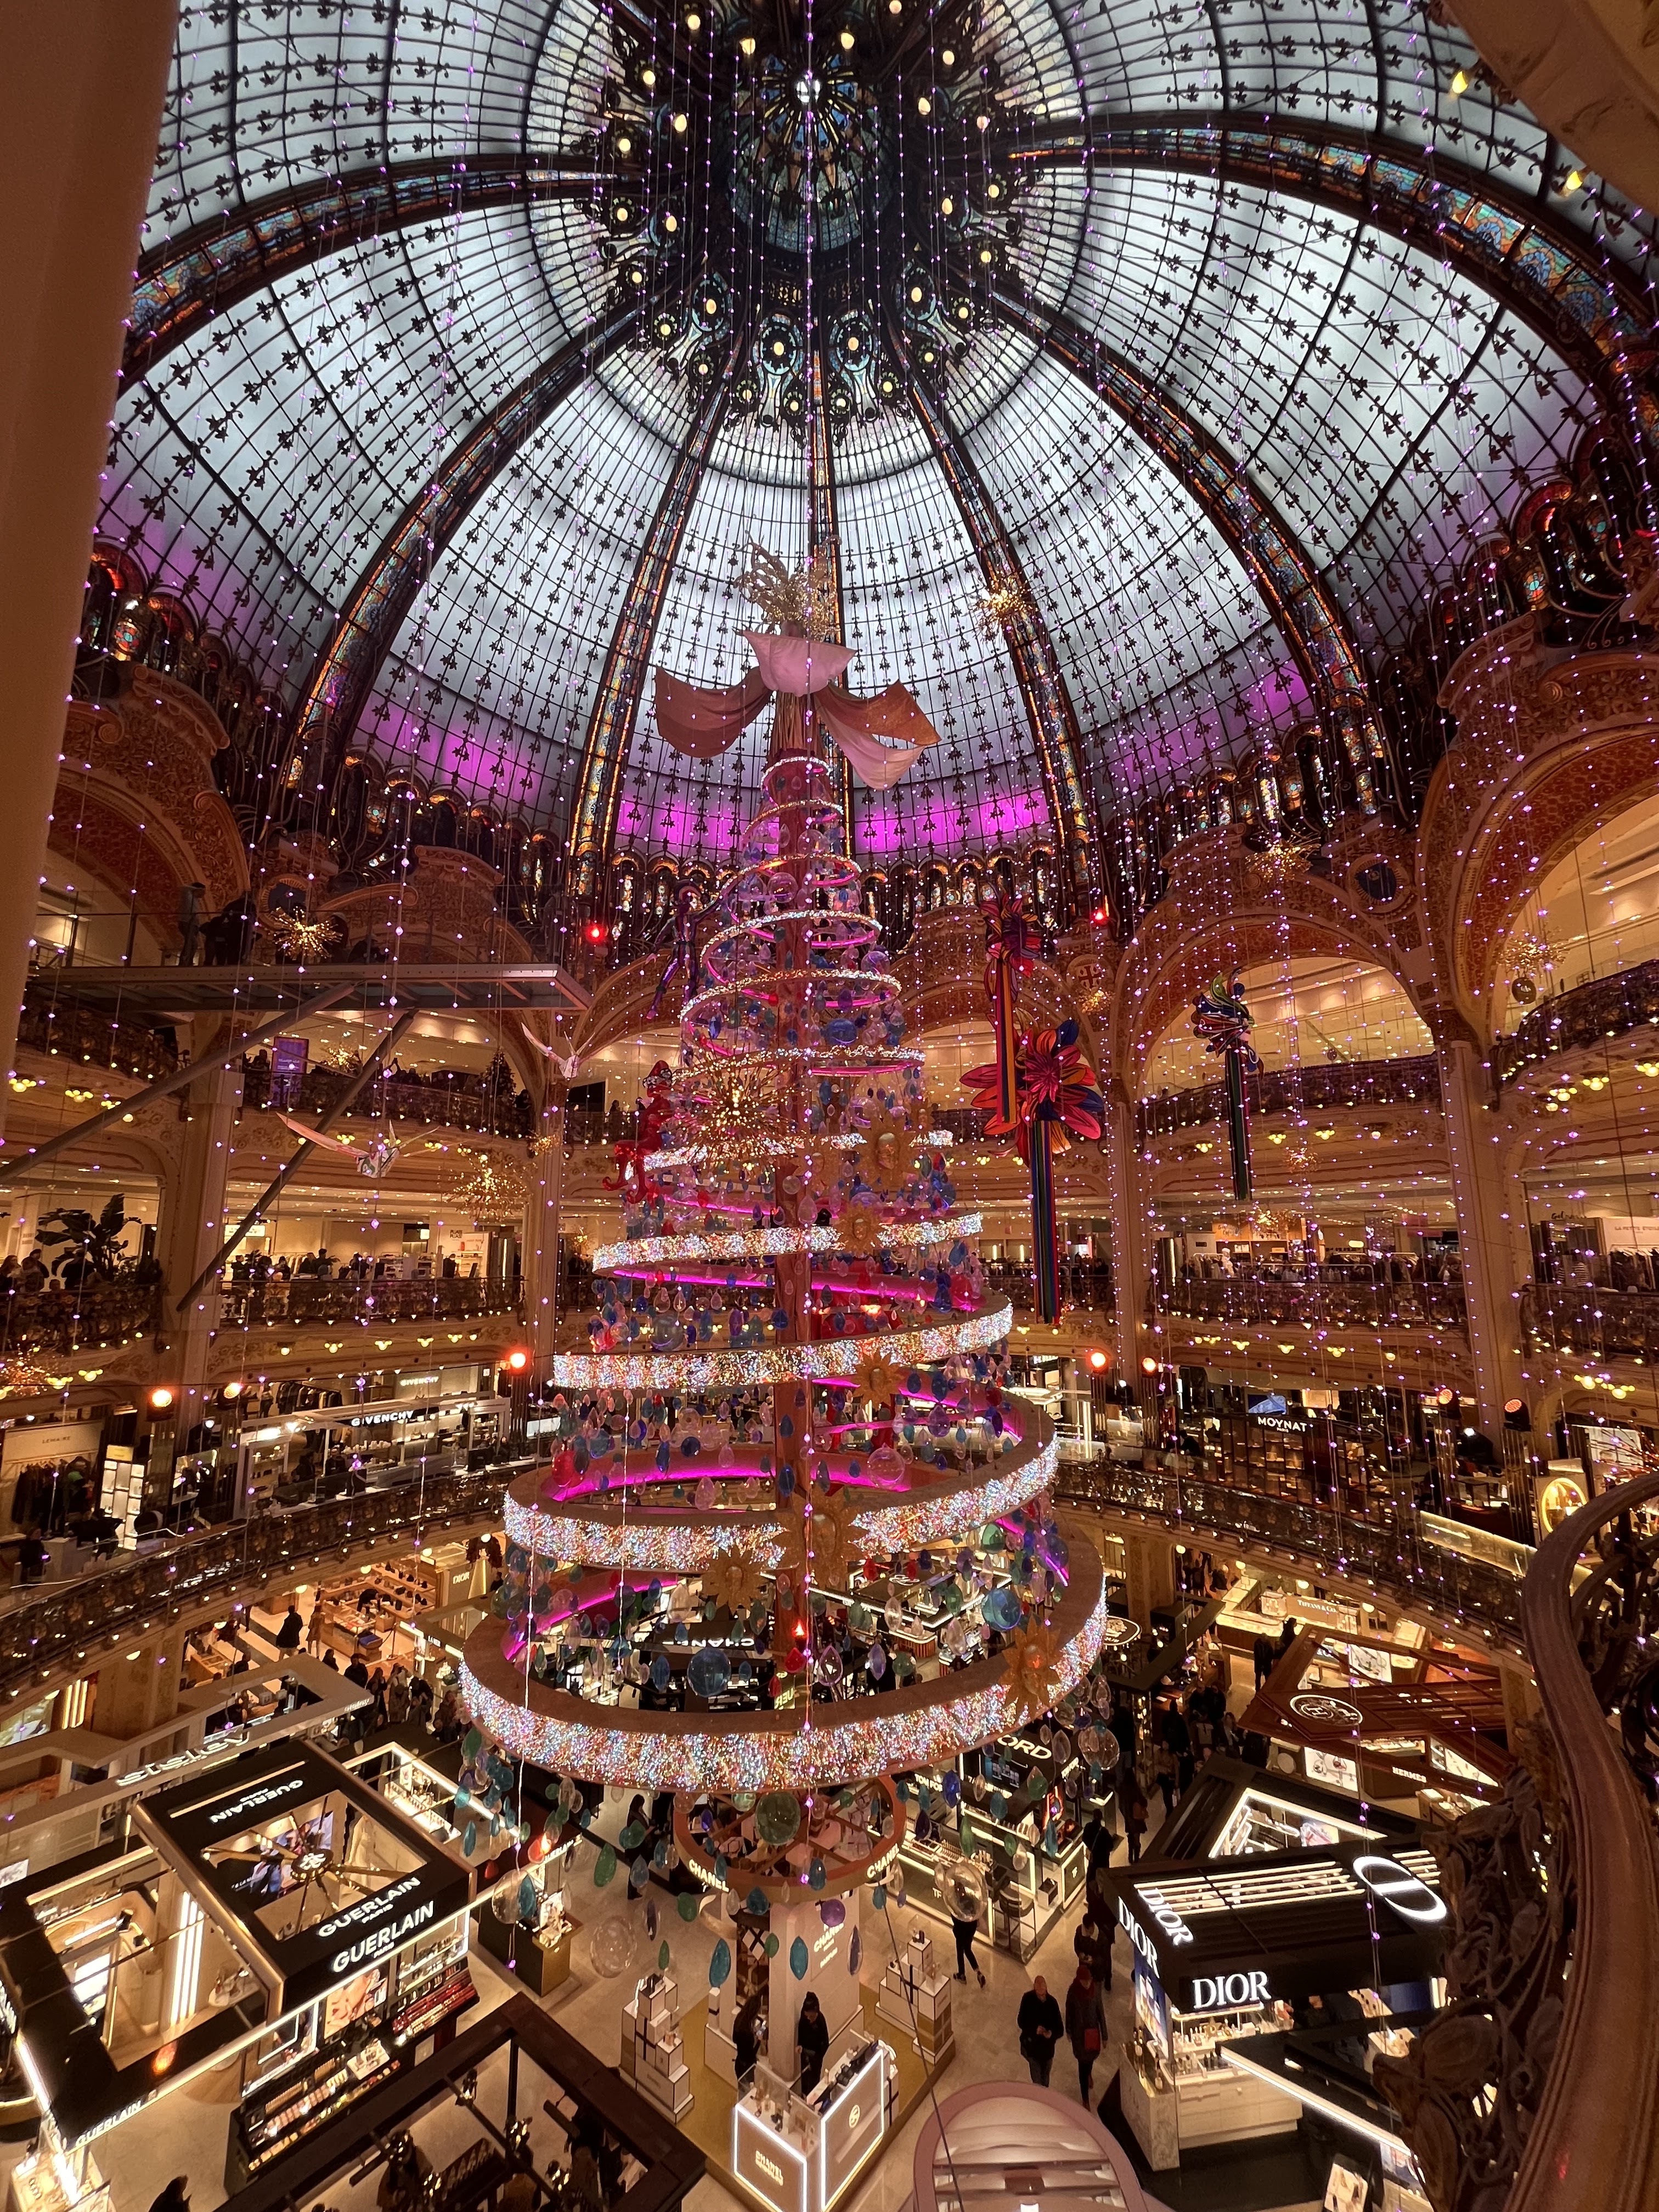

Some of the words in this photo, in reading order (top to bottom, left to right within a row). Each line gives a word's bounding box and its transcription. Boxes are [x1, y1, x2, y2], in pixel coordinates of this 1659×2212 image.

[400, 1376, 439, 1387] GIVENCHY
[351, 1410, 414, 1426] GIVENCHY
[1257, 1416, 1307, 1432] MOYNAT
[453, 1571, 470, 1584] DIOR
[997, 1734, 1052, 1759] ORD
[915, 1773, 932, 1788] TOM
[210, 1780, 303, 1824] GUERLAIN
[689, 1859, 730, 1893] CHANEL
[867, 1843, 900, 1878] CHANEL
[318, 1877, 421, 1937] GUERLAIN
[362, 1903, 394, 1924] PARIS
[1137, 1888, 1194, 1946] DIOR
[332, 1900, 434, 1973] GUERLAIN
[1118, 1895, 1160, 1979] DIOR
[1192, 1971, 1272, 2010] DIOR
[76, 2100, 142, 2147] GUERLAIN
